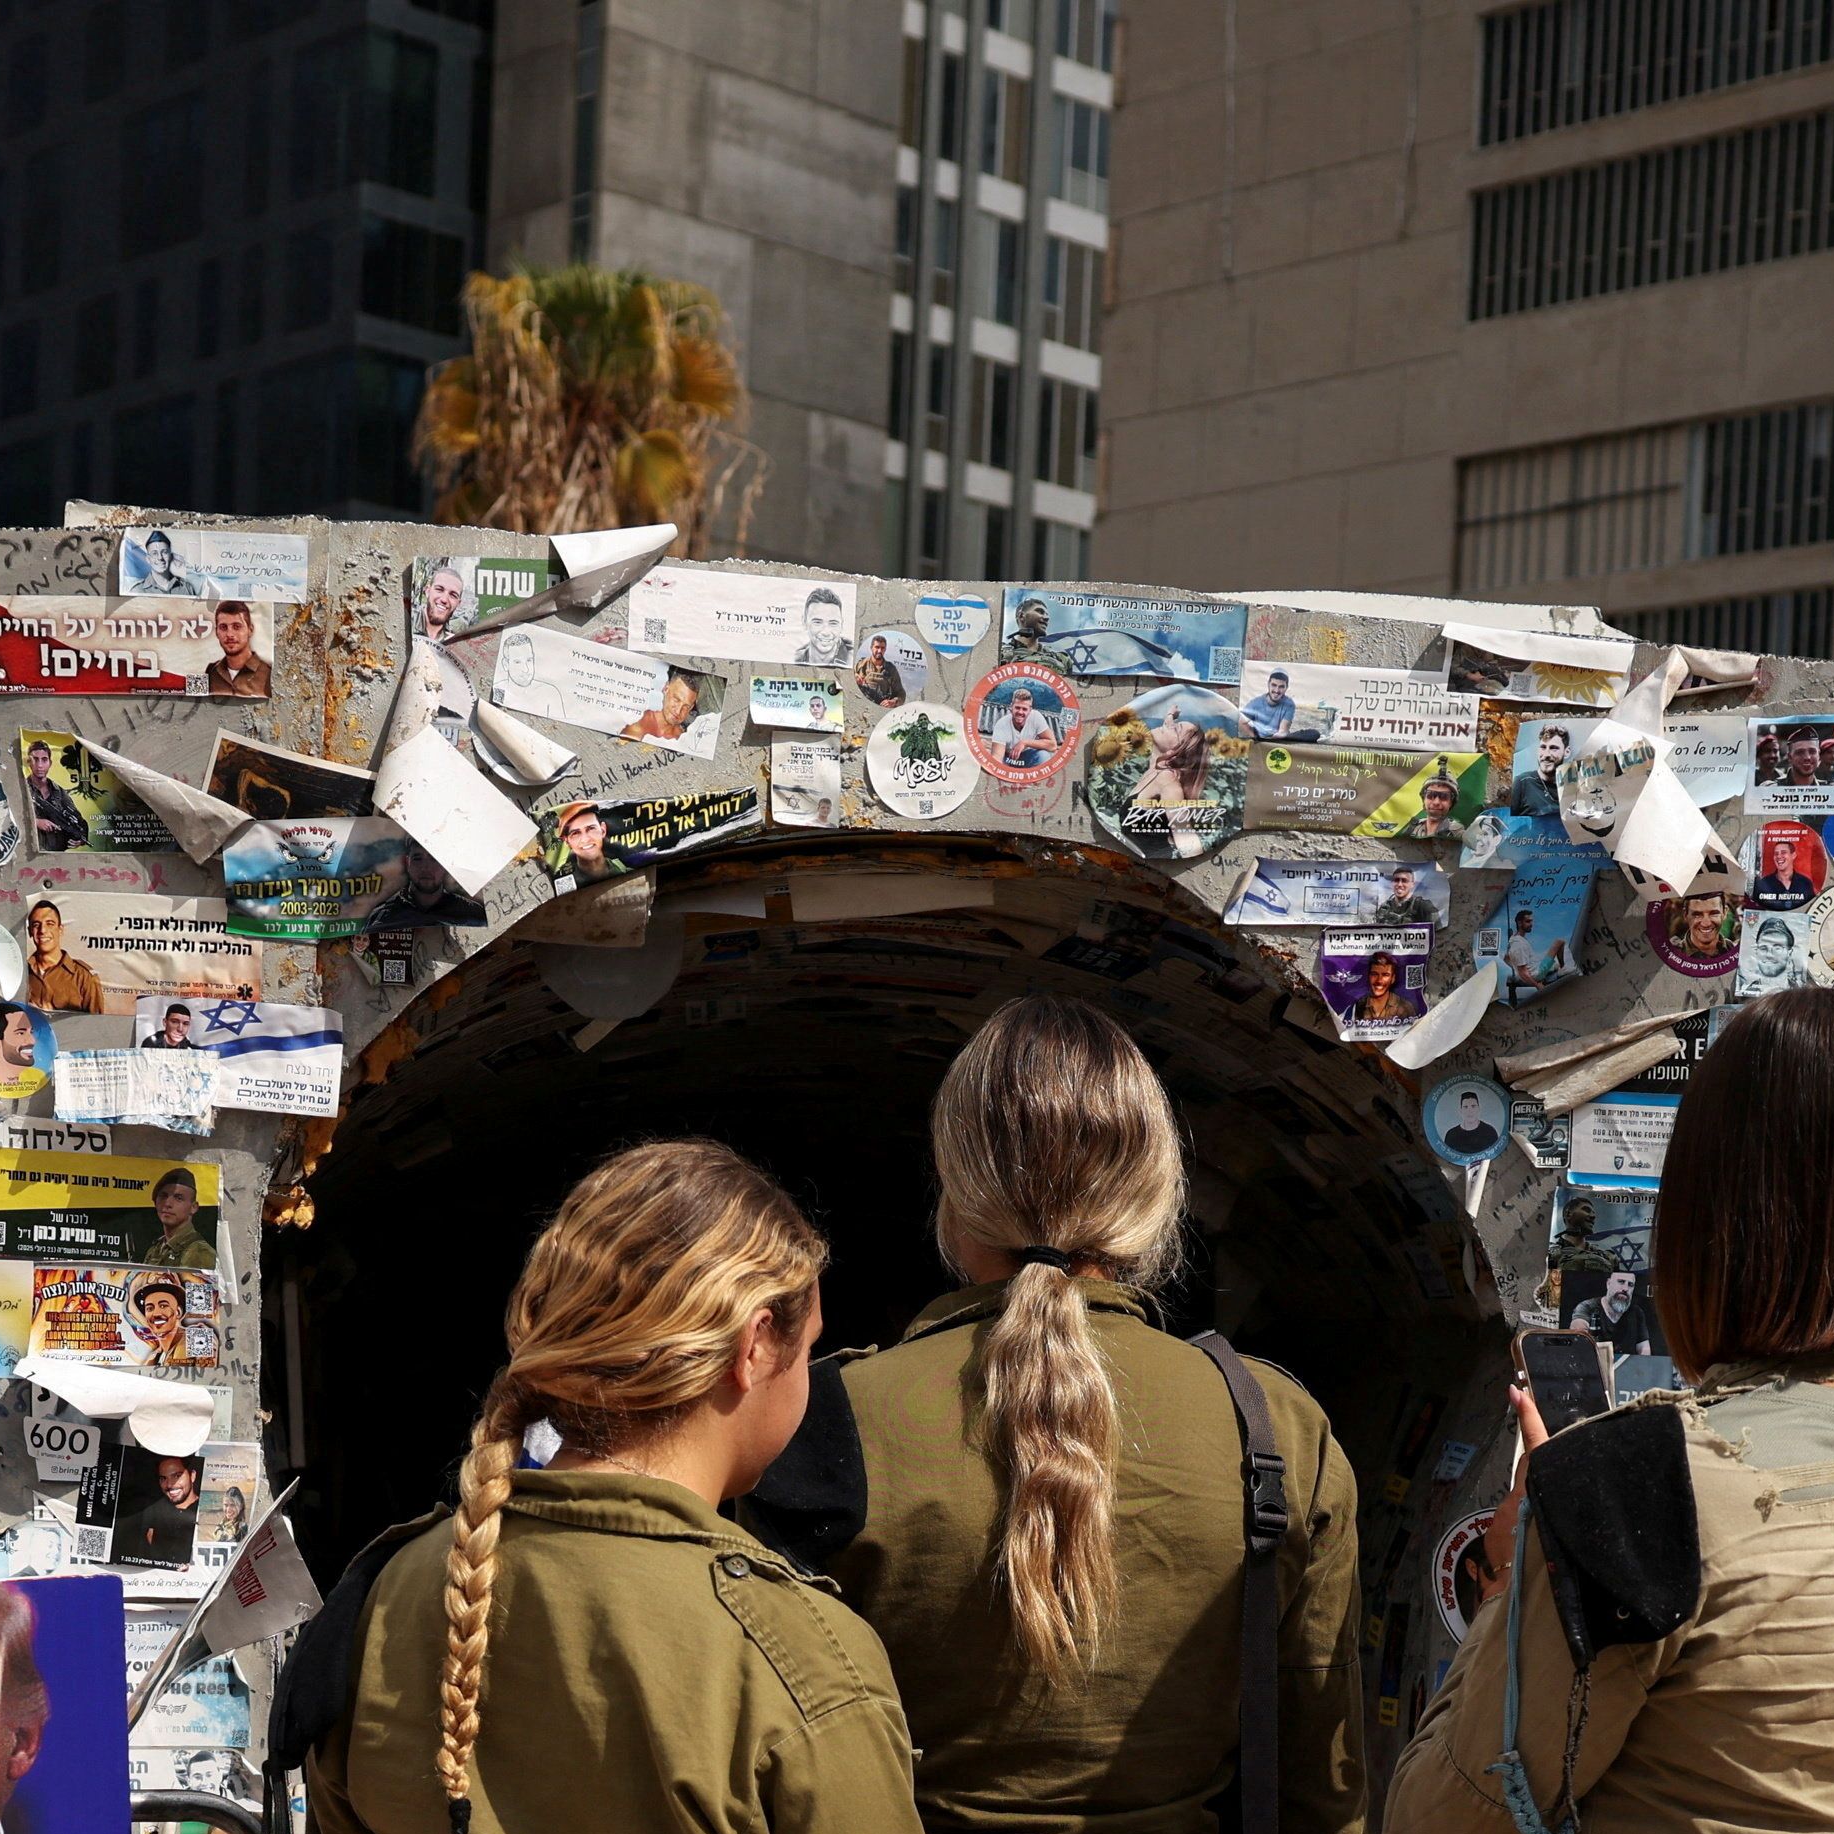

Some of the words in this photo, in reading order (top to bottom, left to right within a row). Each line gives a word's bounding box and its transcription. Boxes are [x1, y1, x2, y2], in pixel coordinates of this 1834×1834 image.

[65, 614, 95, 639] על
[103, 614, 173, 638] לוותר
[182, 614, 213, 638] לא
[933, 618, 971, 632] ישראל
[943, 609, 962, 620] עם
[944, 633, 959, 644] חי
[41, 644, 162, 679] בחיים!
[30, 1423, 89, 1455] 600
